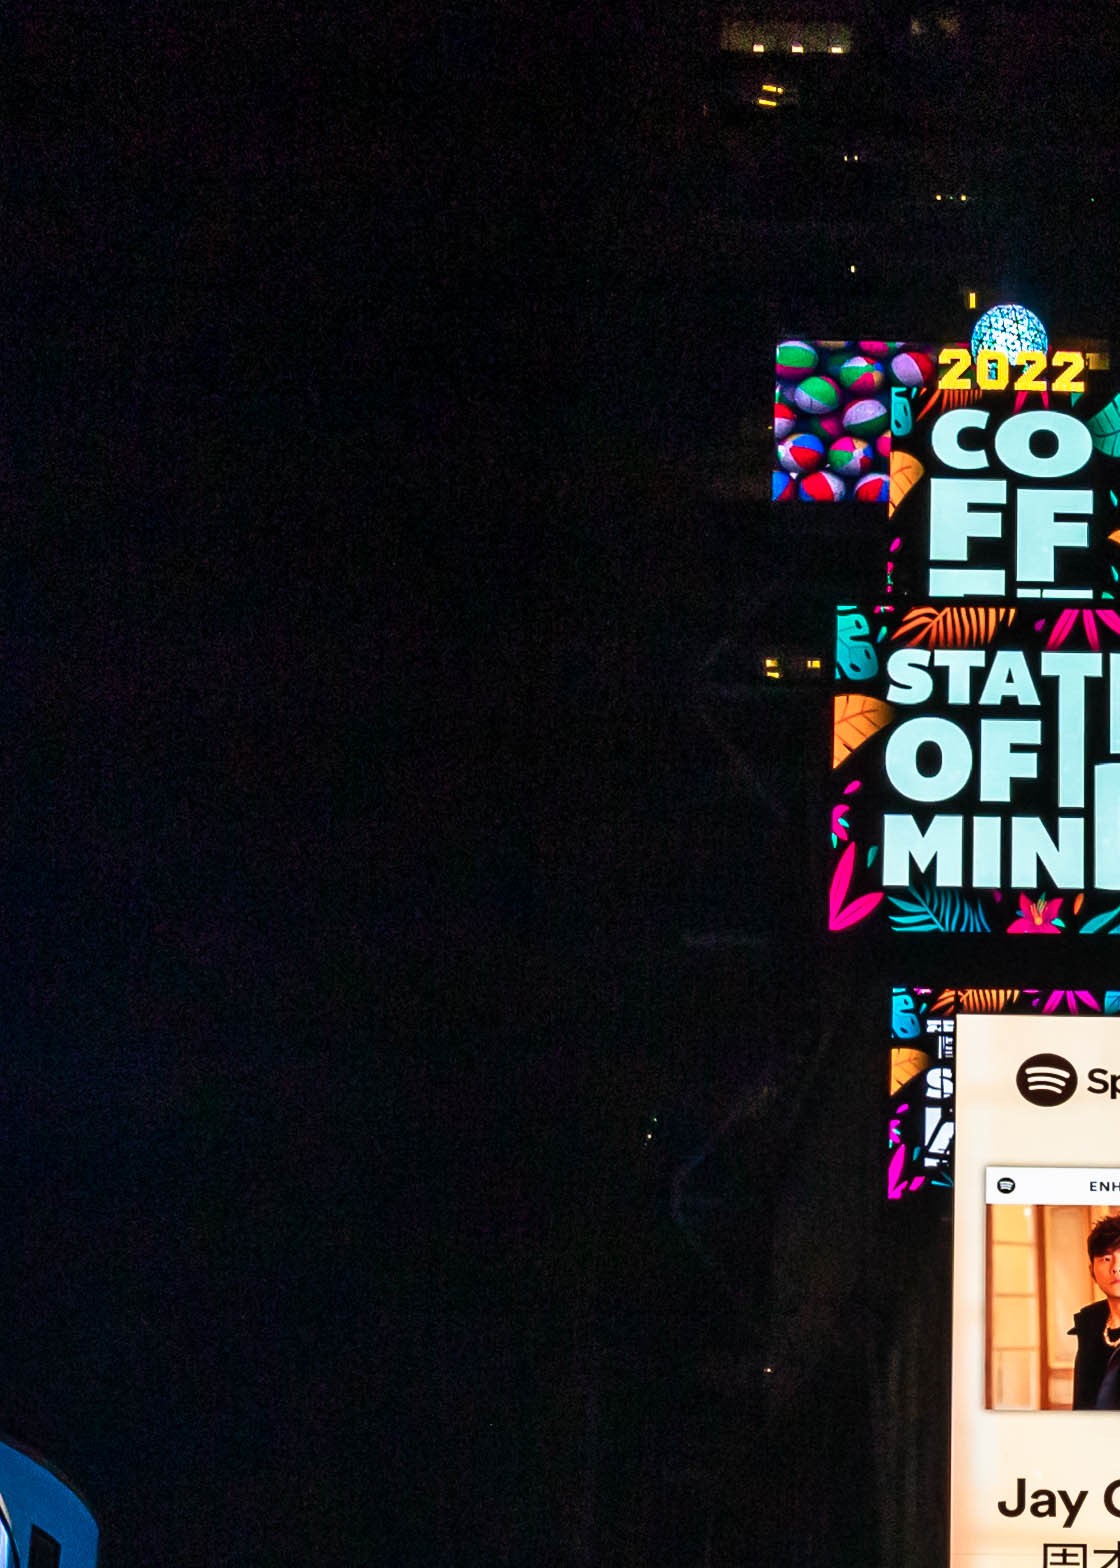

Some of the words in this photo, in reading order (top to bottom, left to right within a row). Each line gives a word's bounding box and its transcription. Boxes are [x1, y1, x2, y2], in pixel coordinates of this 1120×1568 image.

[937, 346, 1086, 392] 2022
[931, 408, 1094, 478] CO
[884, 716, 1042, 804] OF
[998, 1478, 1089, 1528] Jay
